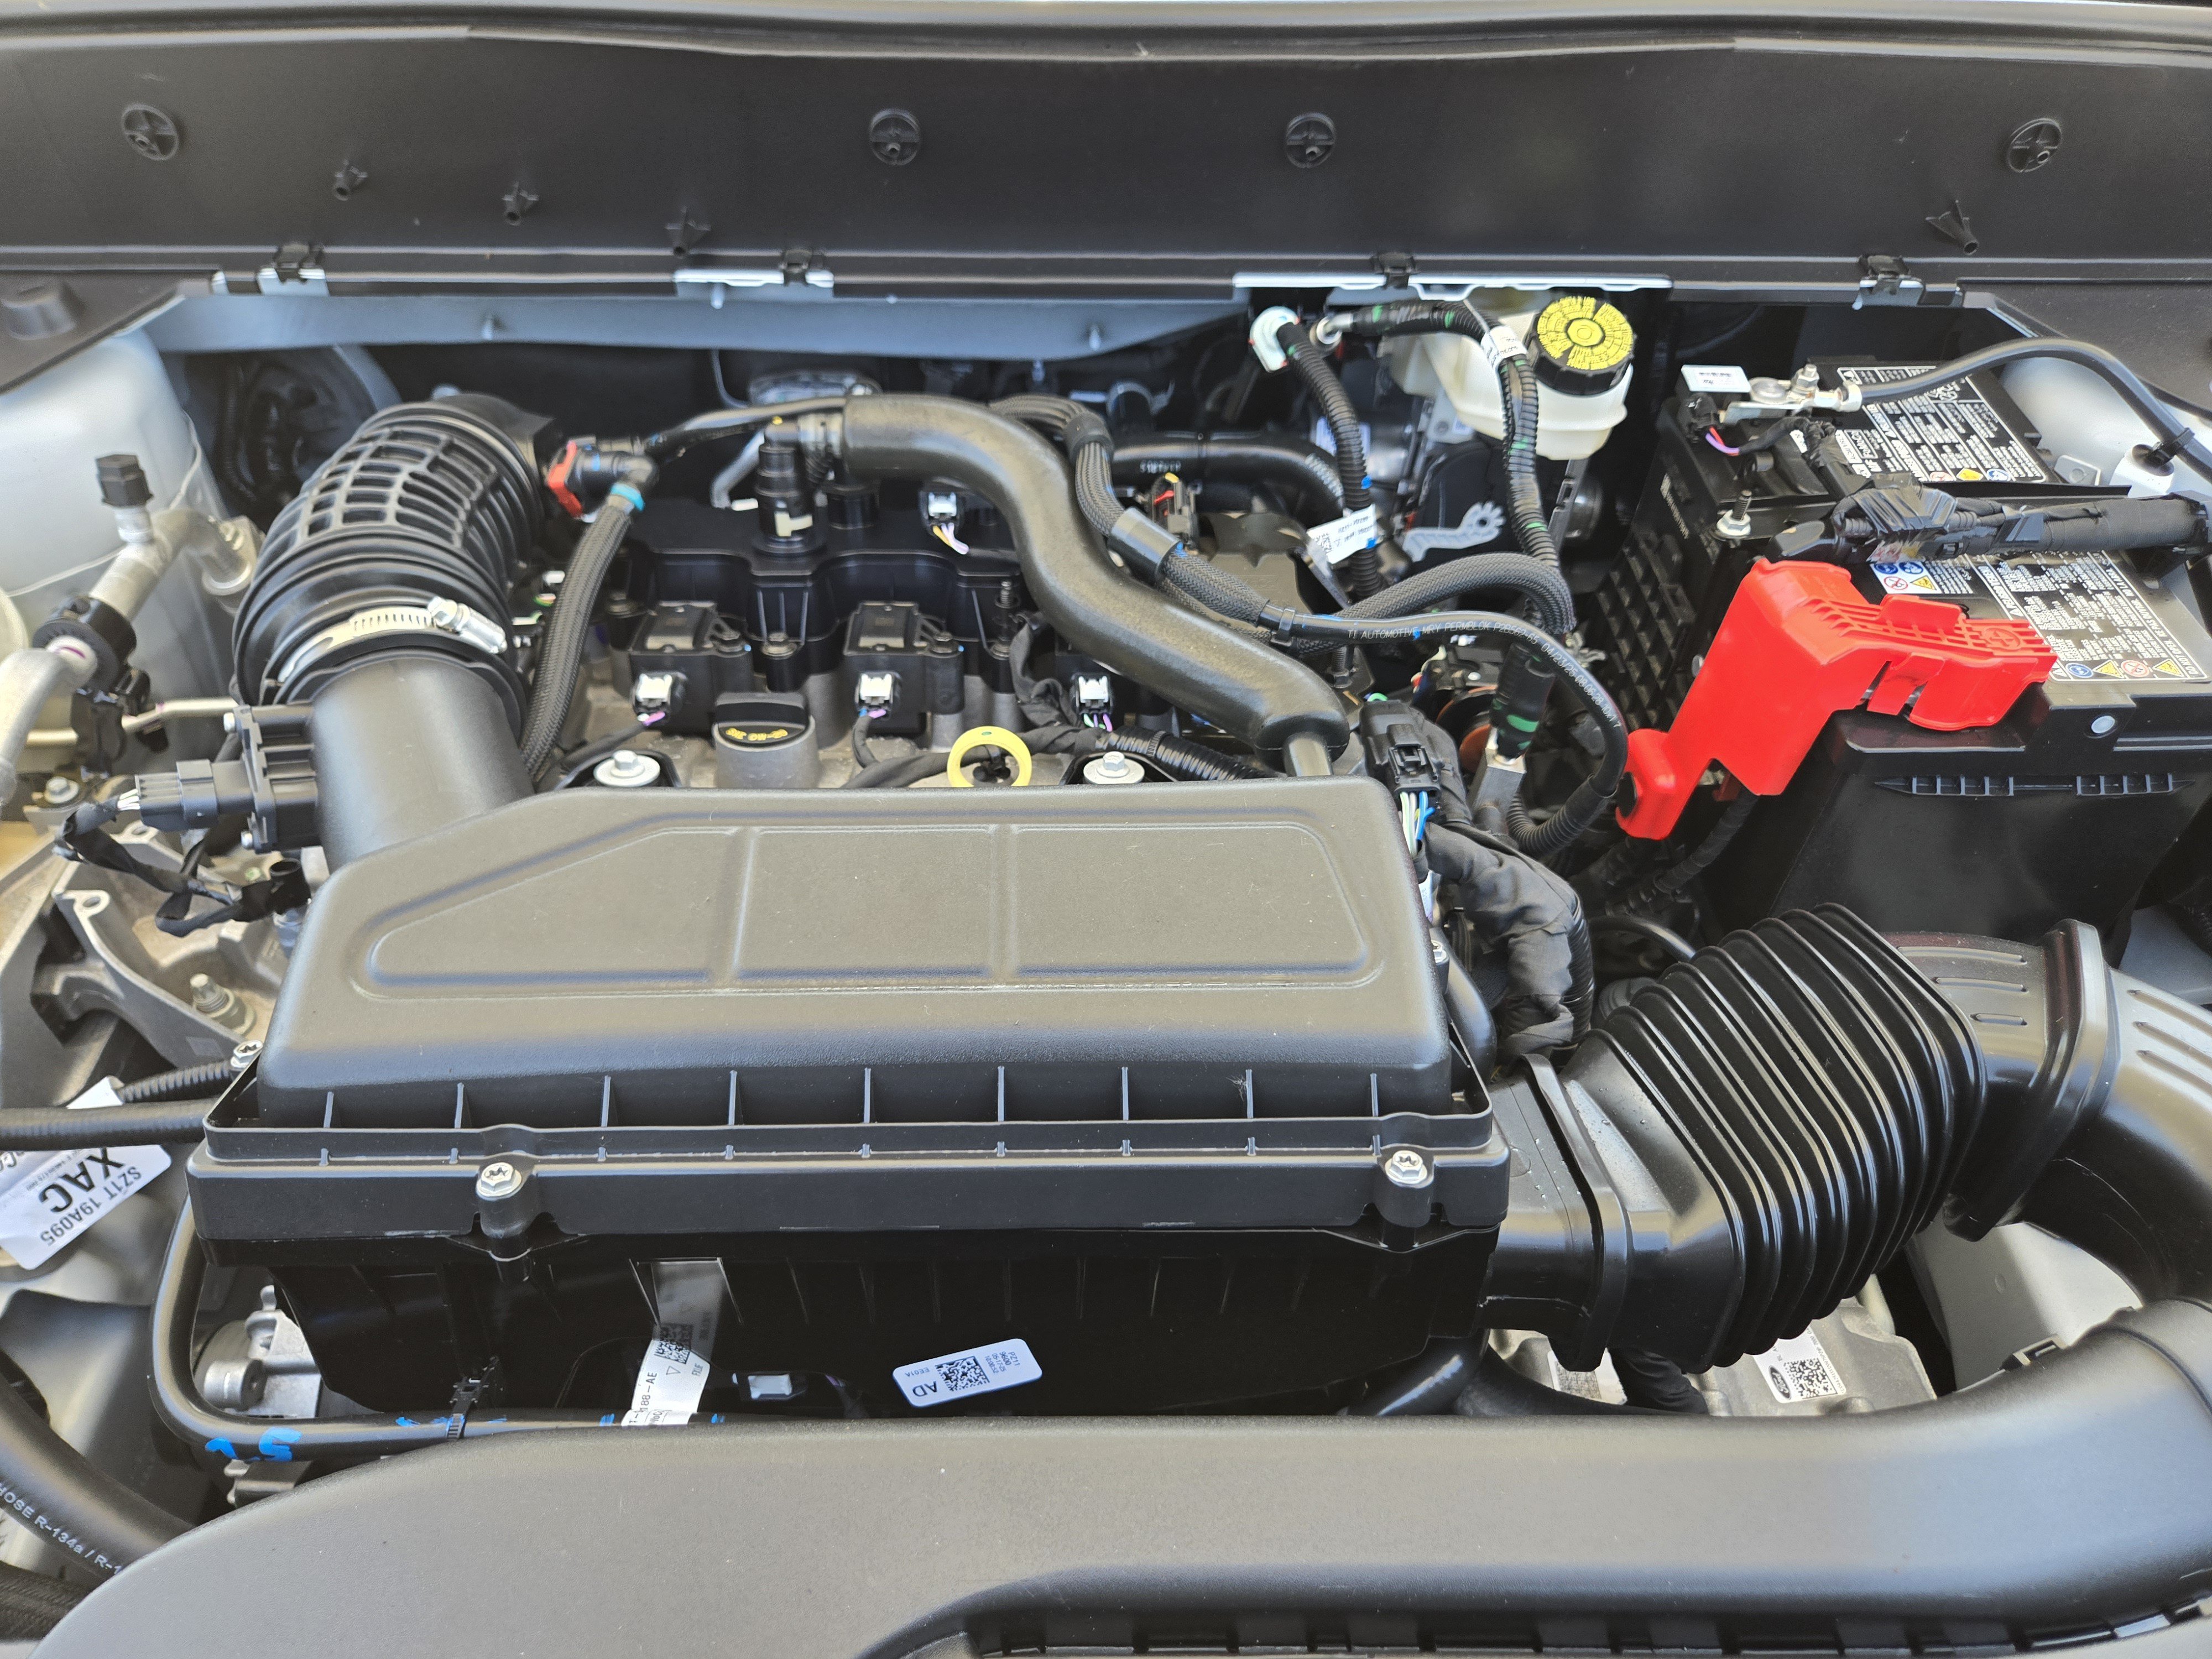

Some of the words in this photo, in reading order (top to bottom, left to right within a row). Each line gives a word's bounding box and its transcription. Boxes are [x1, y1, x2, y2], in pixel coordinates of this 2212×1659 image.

[1348, 630, 1356, 639] TI
[1360, 627, 1418, 639] AUTOMOTIVE
[1422, 624, 1441, 635] MRY
[2174, 655, 2192, 665] NOT
[38, 1147, 124, 1213] XAC
[103, 1166, 142, 1200] SZ1T
[40, 1197, 102, 1246] 19A095
[999, 1351, 1012, 1366] 9600
[905, 1366, 930, 1377] EE01A
[912, 1381, 938, 1403] AD
[0, 1483, 35, 1519] HOSE
[34, 1515, 84, 1554] R-134a
